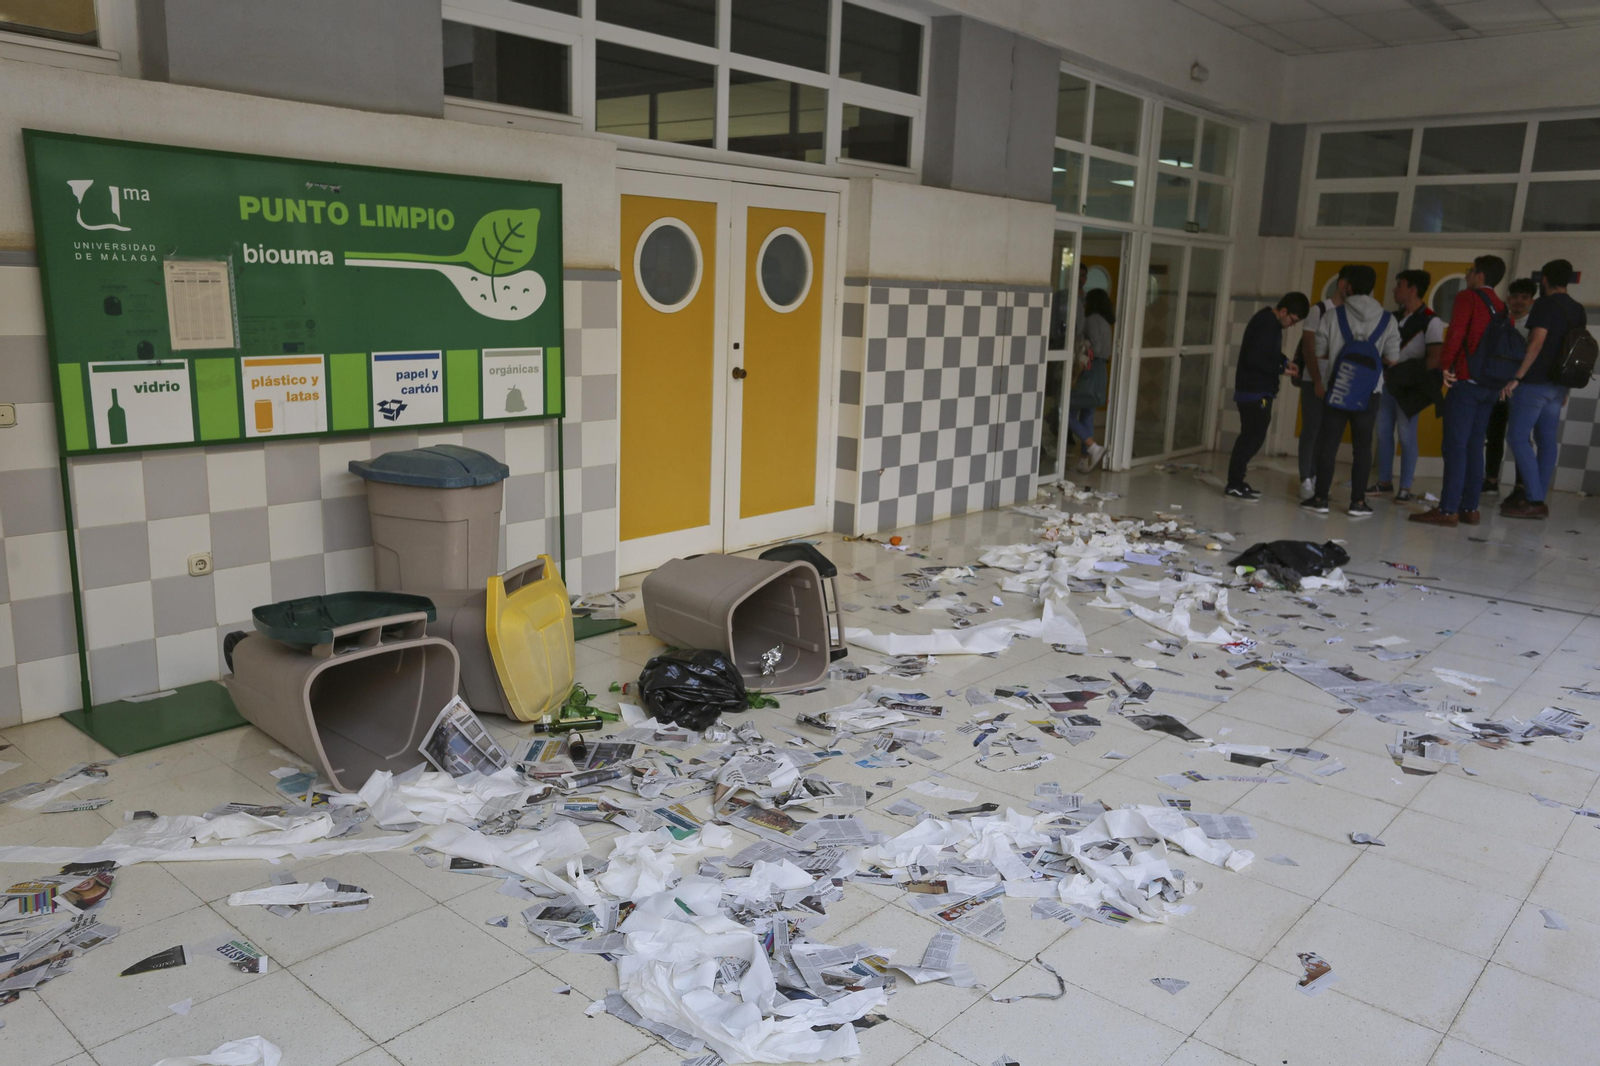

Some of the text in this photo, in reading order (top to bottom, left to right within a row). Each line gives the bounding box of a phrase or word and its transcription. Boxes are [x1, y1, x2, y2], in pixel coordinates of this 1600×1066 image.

[238, 195, 455, 231] PUNTO LIMPIO
[73, 241, 156, 252] UNIVERSIDAD
[75, 252, 157, 262] DE MÁLAGA
[242, 242, 334, 266] biouma
[395, 368, 439, 382] papel y
[488, 364, 540, 376] orgánicas
[133, 380, 181, 394] vidrio
[250, 375, 319, 390] plástico y
[400, 383, 439, 395] cartón
[1329, 362, 1356, 406] PUMA
[286, 391, 319, 402] latas
